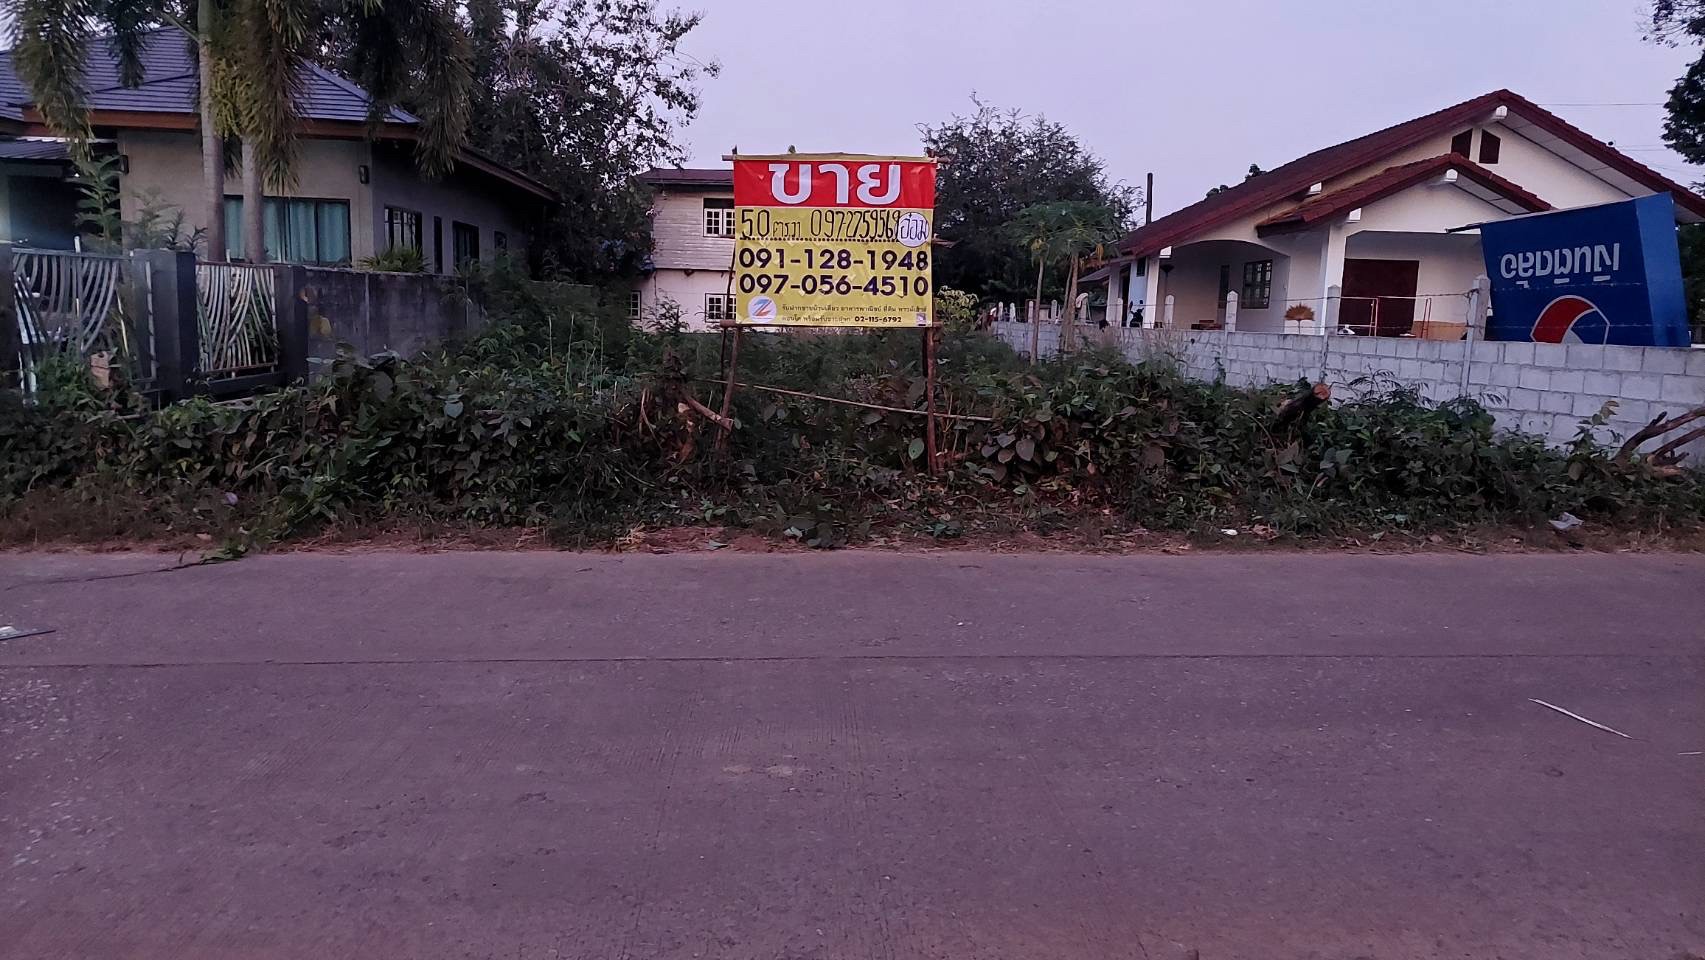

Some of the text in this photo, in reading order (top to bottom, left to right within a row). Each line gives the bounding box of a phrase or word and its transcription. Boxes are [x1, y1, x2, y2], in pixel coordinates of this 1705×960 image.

[768, 163, 901, 205] ขาย
[738, 247, 929, 271] 091-128-1948
[1500, 243, 1620, 289] เงินติดล้อ
[738, 273, 929, 296] 097-056-4510
